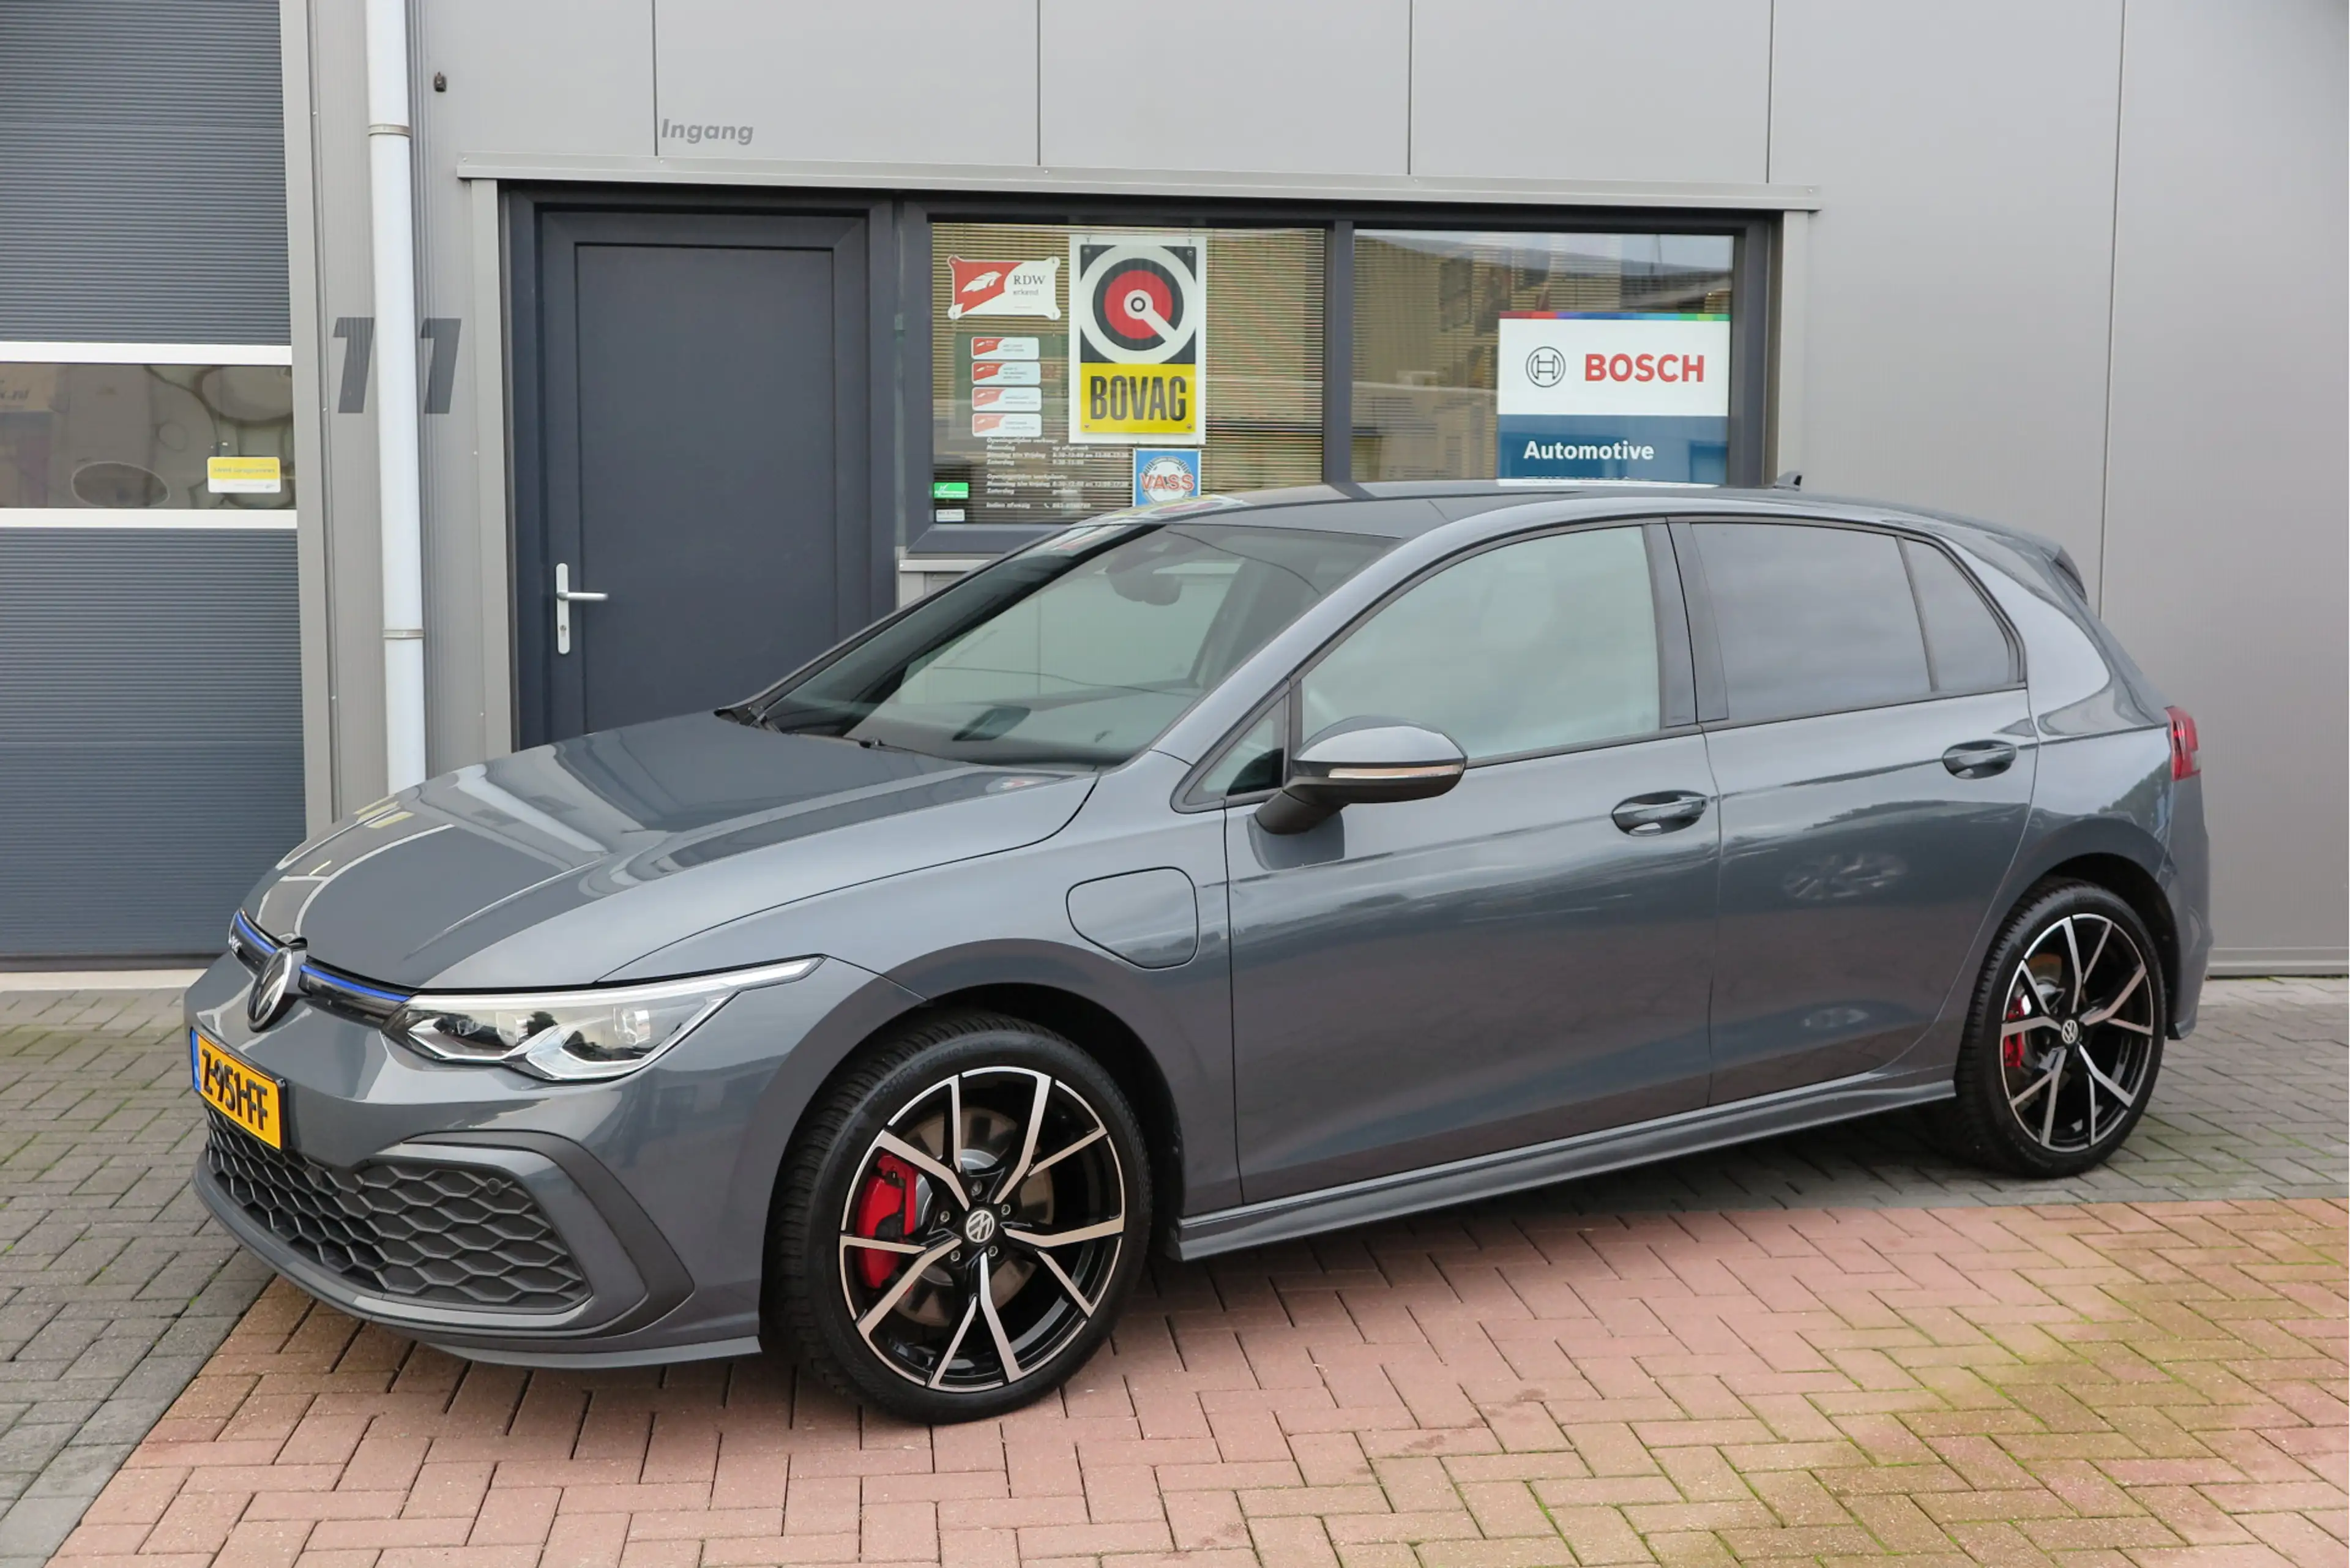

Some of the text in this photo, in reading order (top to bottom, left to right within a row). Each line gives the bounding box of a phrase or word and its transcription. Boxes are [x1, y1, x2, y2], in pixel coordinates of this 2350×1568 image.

[662, 118, 753, 146] Ingang
[1013, 274, 1046, 285] RDW
[1584, 353, 1705, 383] BOSCH
[1090, 375, 1187, 420] BOVAG
[1523, 440, 1655, 460] Automotive
[1140, 473, 1195, 491] VASS
[202, 1049, 268, 1131] Z-951-FF
